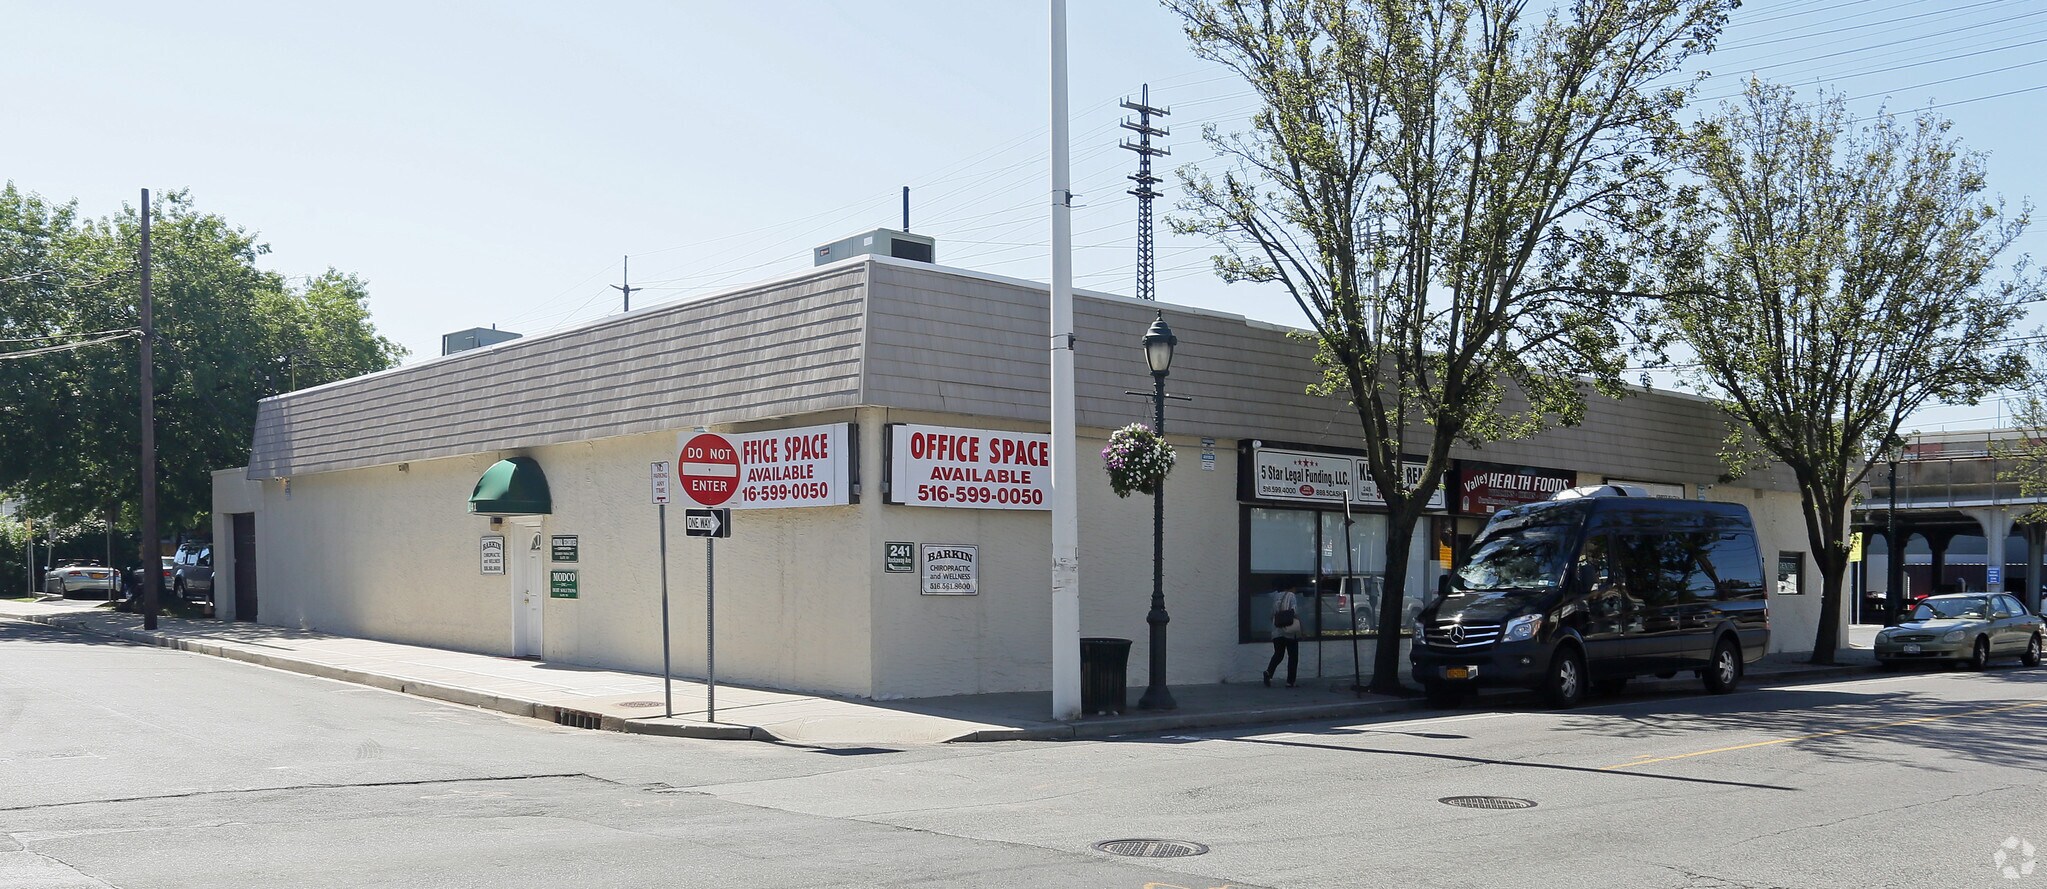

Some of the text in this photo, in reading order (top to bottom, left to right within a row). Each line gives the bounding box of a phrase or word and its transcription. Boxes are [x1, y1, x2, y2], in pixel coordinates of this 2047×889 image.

[687, 447, 731, 460] DO NOT
[741, 433, 828, 465] FFICE SPACE
[911, 432, 1049, 467] OFFICE SPACE
[747, 464, 814, 483] AVAILABLE
[930, 466, 1032, 485] AVAILABLE
[1261, 465, 1267, 479] 5
[1268, 465, 1284, 481] Star
[1284, 467, 1304, 485] Legal
[1305, 468, 1335, 487] Funding,
[1335, 471, 1350, 486] LLC.
[1464, 472, 1569, 493] Valley HEALTH FOODS
[692, 480, 728, 492] ENTER
[742, 481, 828, 502] 16-599-0050
[917, 484, 1043, 505] 516-599-0050
[688, 517, 711, 529] ONE WAY
[890, 545, 910, 557] 241
[927, 550, 973, 563] BARKIN
[553, 573, 576, 582] MODCO
